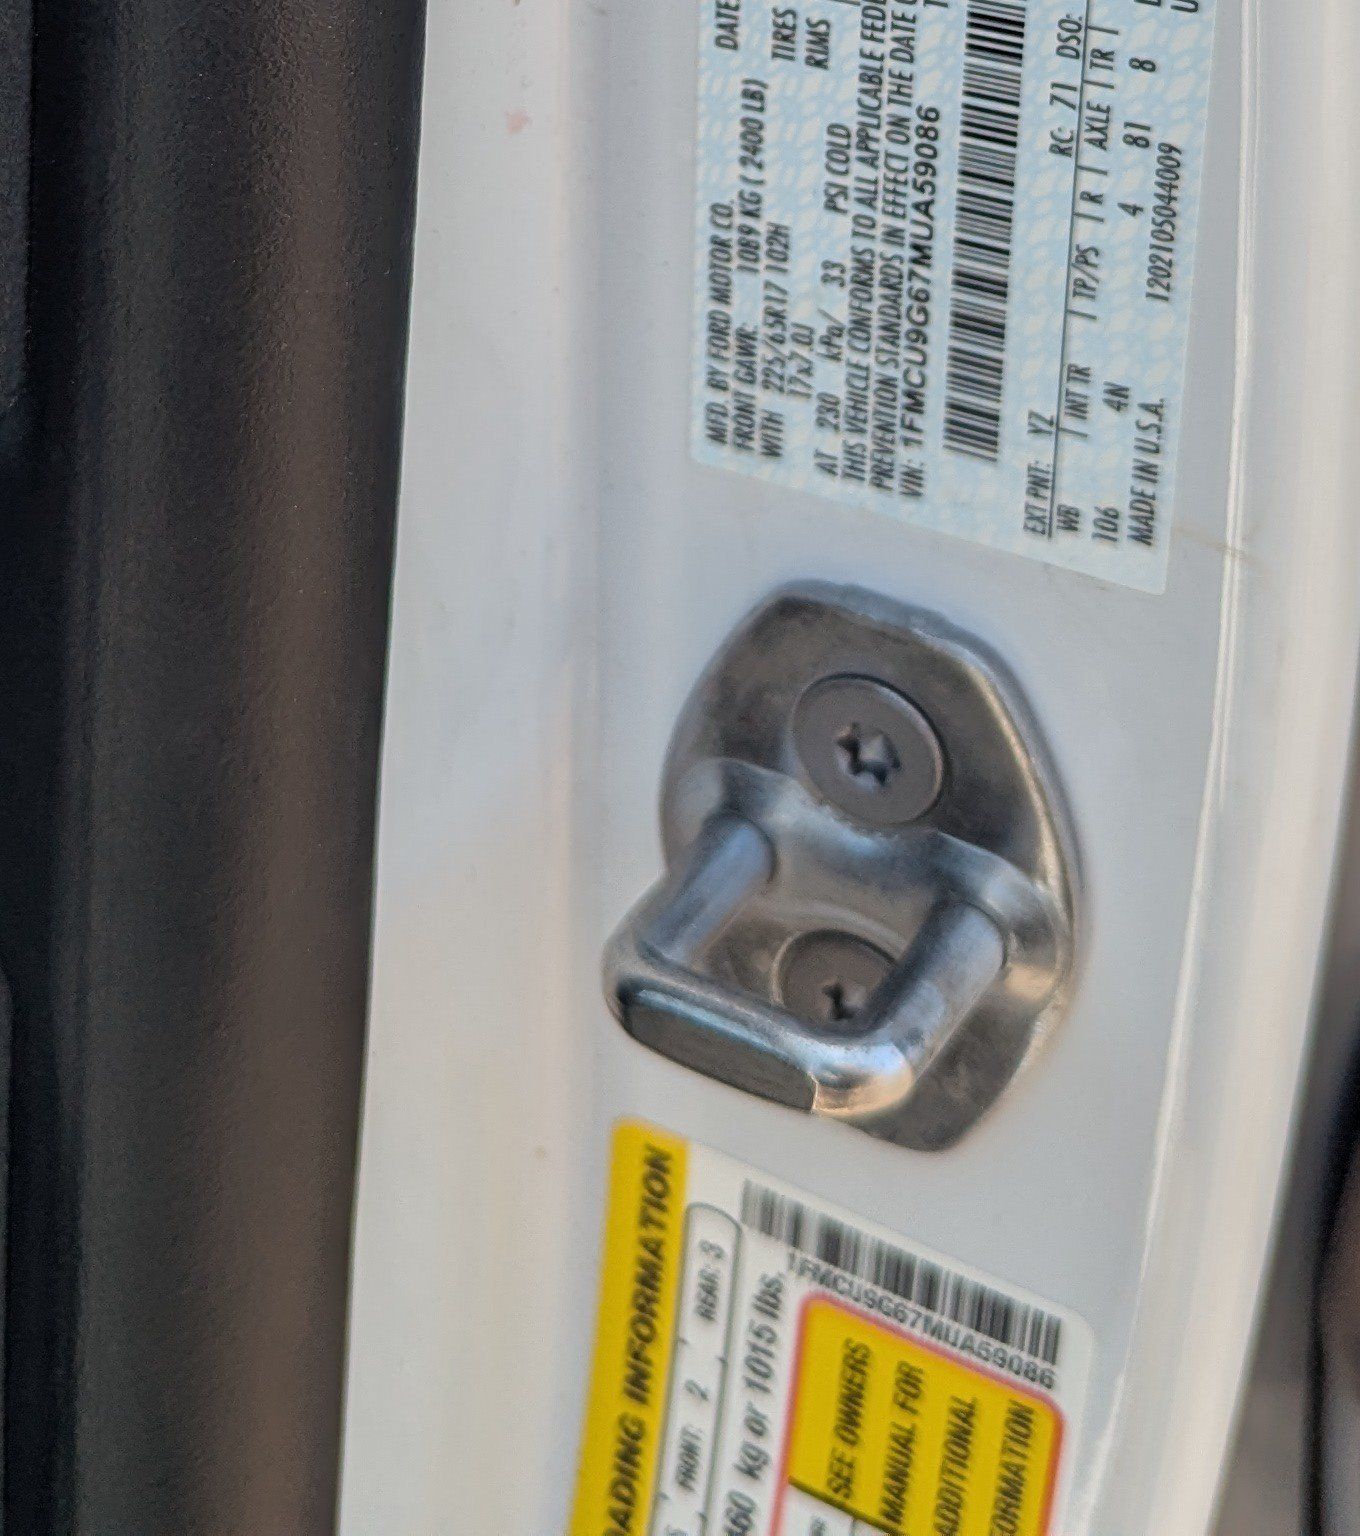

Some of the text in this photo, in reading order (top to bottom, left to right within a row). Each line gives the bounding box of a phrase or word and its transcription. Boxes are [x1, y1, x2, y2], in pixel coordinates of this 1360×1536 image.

[770, 7, 798, 62] TIRES
[803, 16, 831, 71] RIMS
[888, 9, 918, 65] DATE
[1088, 47, 1116, 71] TR
[885, 67, 914, 108] THE
[1047, 12, 1084, 158] RC: 71 DSO:
[1127, 56, 1157, 73] 8
[740, 77, 768, 114] LB)
[854, 47, 886, 171] APPLICABLE
[737, 116, 765, 171] 2400
[884, 112, 912, 146] ON
[1083, 99, 1112, 152] AXLE
[1121, 120, 1151, 150] 81
[737, 189, 762, 219] KG
[852, 175, 879, 212] ALL
[880, 149, 910, 221] EFFECT
[1078, 190, 1104, 206] R
[1116, 201, 1145, 217] 4
[735, 222, 761, 274] 1089
[850, 212, 877, 241] TO
[880, 224, 906, 248] IN
[1144, 141, 1183, 302] 1202105044009
[812, 121, 852, 477] AT 230 kPa/ 33 PSI COLD
[845, 245, 876, 354] CONFORMS
[1071, 243, 1101, 301] TP/PS
[704, 199, 734, 446] MFD. BY FORD MOTOR CO.
[874, 251, 905, 369] STANDARDS
[898, 104, 941, 500] VIN: 1FMCU9G67MUA59086
[732, 322, 758, 386] GAWR:
[759, 221, 791, 459] WITH 225/65R17 102H
[842, 358, 871, 435] VEHICLE
[1063, 362, 1091, 421] INT TR
[1102, 381, 1130, 413] 4N
[731, 389, 756, 452] FRONT
[869, 372, 899, 492] PREVENTION
[841, 440, 867, 482] THIS
[1022, 410, 1056, 536] EXT PNT: YZ
[1126, 397, 1165, 547] MADE IN U.S.A.
[1055, 503, 1081, 532] WB
[1091, 505, 1121, 543] 106
[621, 1144, 672, 1406] INFORMATION
[697, 1239, 725, 1262] 3
[749, 1271, 786, 1323] lbs.
[742, 1318, 778, 1395] 1015
[742, 1400, 768, 1440] or
[825, 1338, 871, 1502] SEE OWNERS
[875, 1360, 924, 1529] MANUAL FOR
[732, 1439, 771, 1483] kg
[929, 1396, 977, 1536] ADDITIONAL
